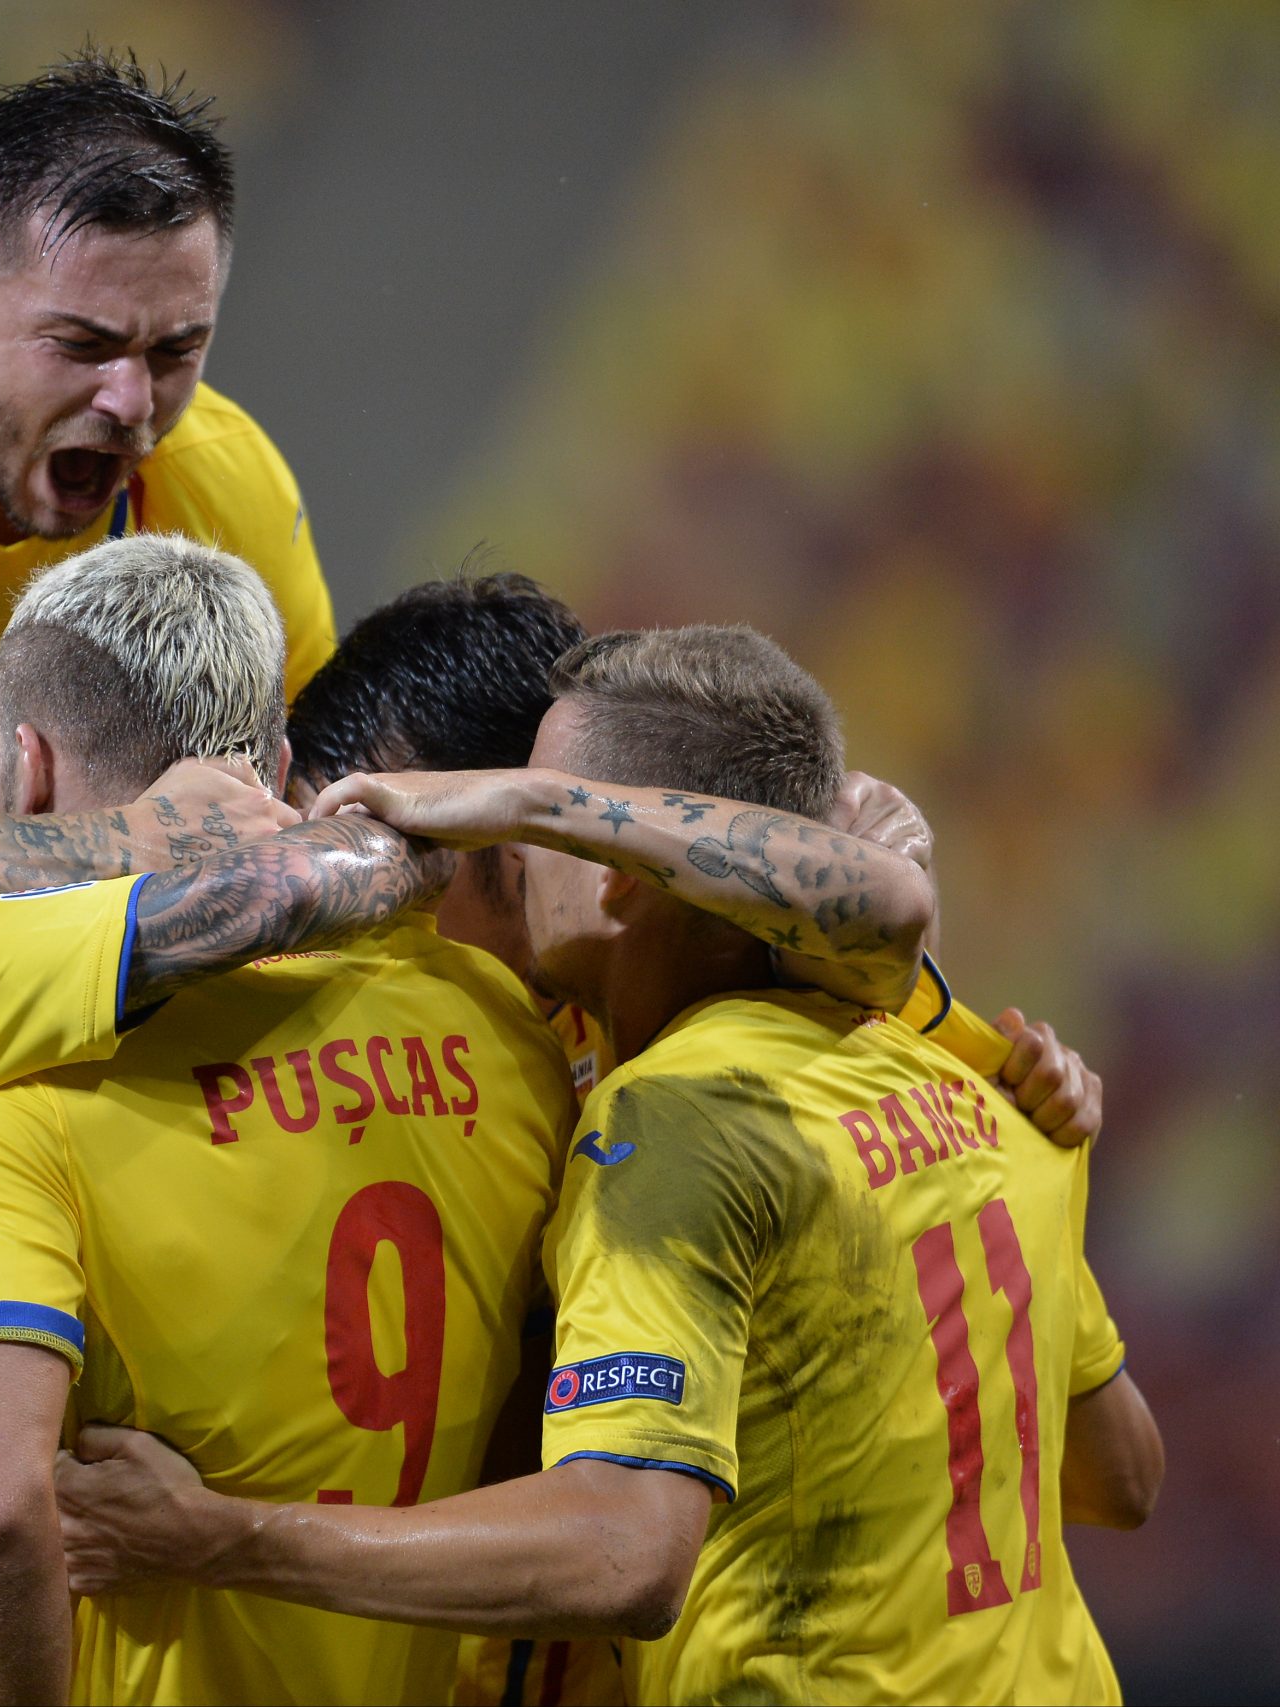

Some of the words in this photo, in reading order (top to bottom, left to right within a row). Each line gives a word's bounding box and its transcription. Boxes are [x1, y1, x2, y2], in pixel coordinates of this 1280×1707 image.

[316, 1180, 446, 1507] 9
[581, 1364, 684, 1394] RESPECT
[911, 1197, 1043, 1617] 11
